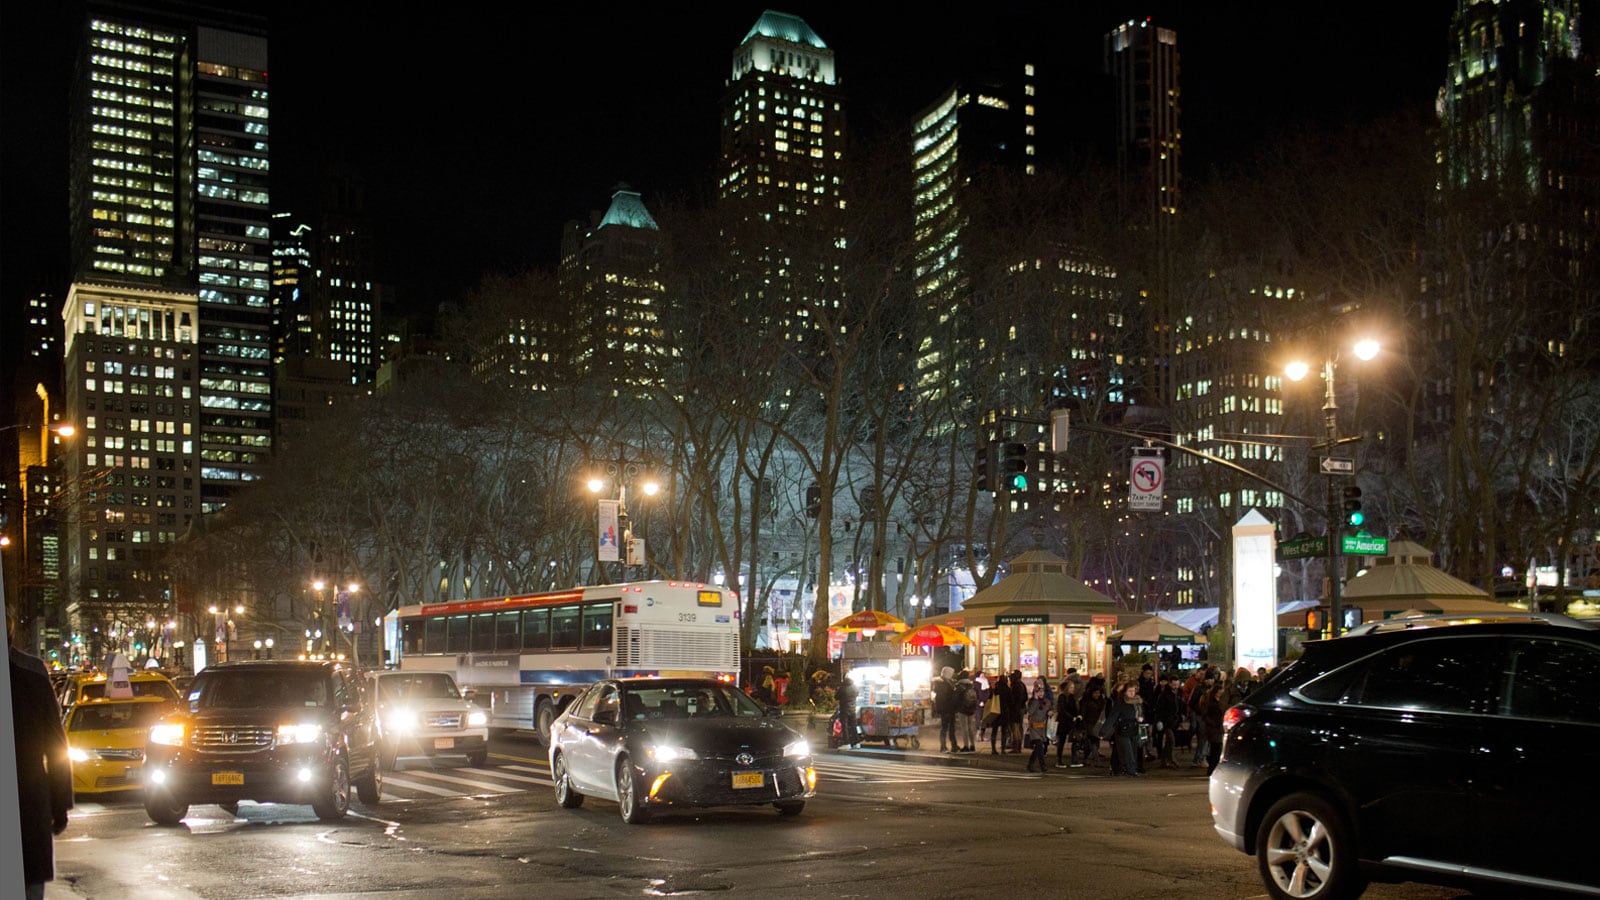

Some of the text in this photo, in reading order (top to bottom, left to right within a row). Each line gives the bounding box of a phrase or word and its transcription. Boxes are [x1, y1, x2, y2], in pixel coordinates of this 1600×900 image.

[1282, 546, 1299, 555] West
[1316, 542, 1324, 551] St
[1356, 541, 1384, 551] Americas
[678, 613, 696, 622] 3139
